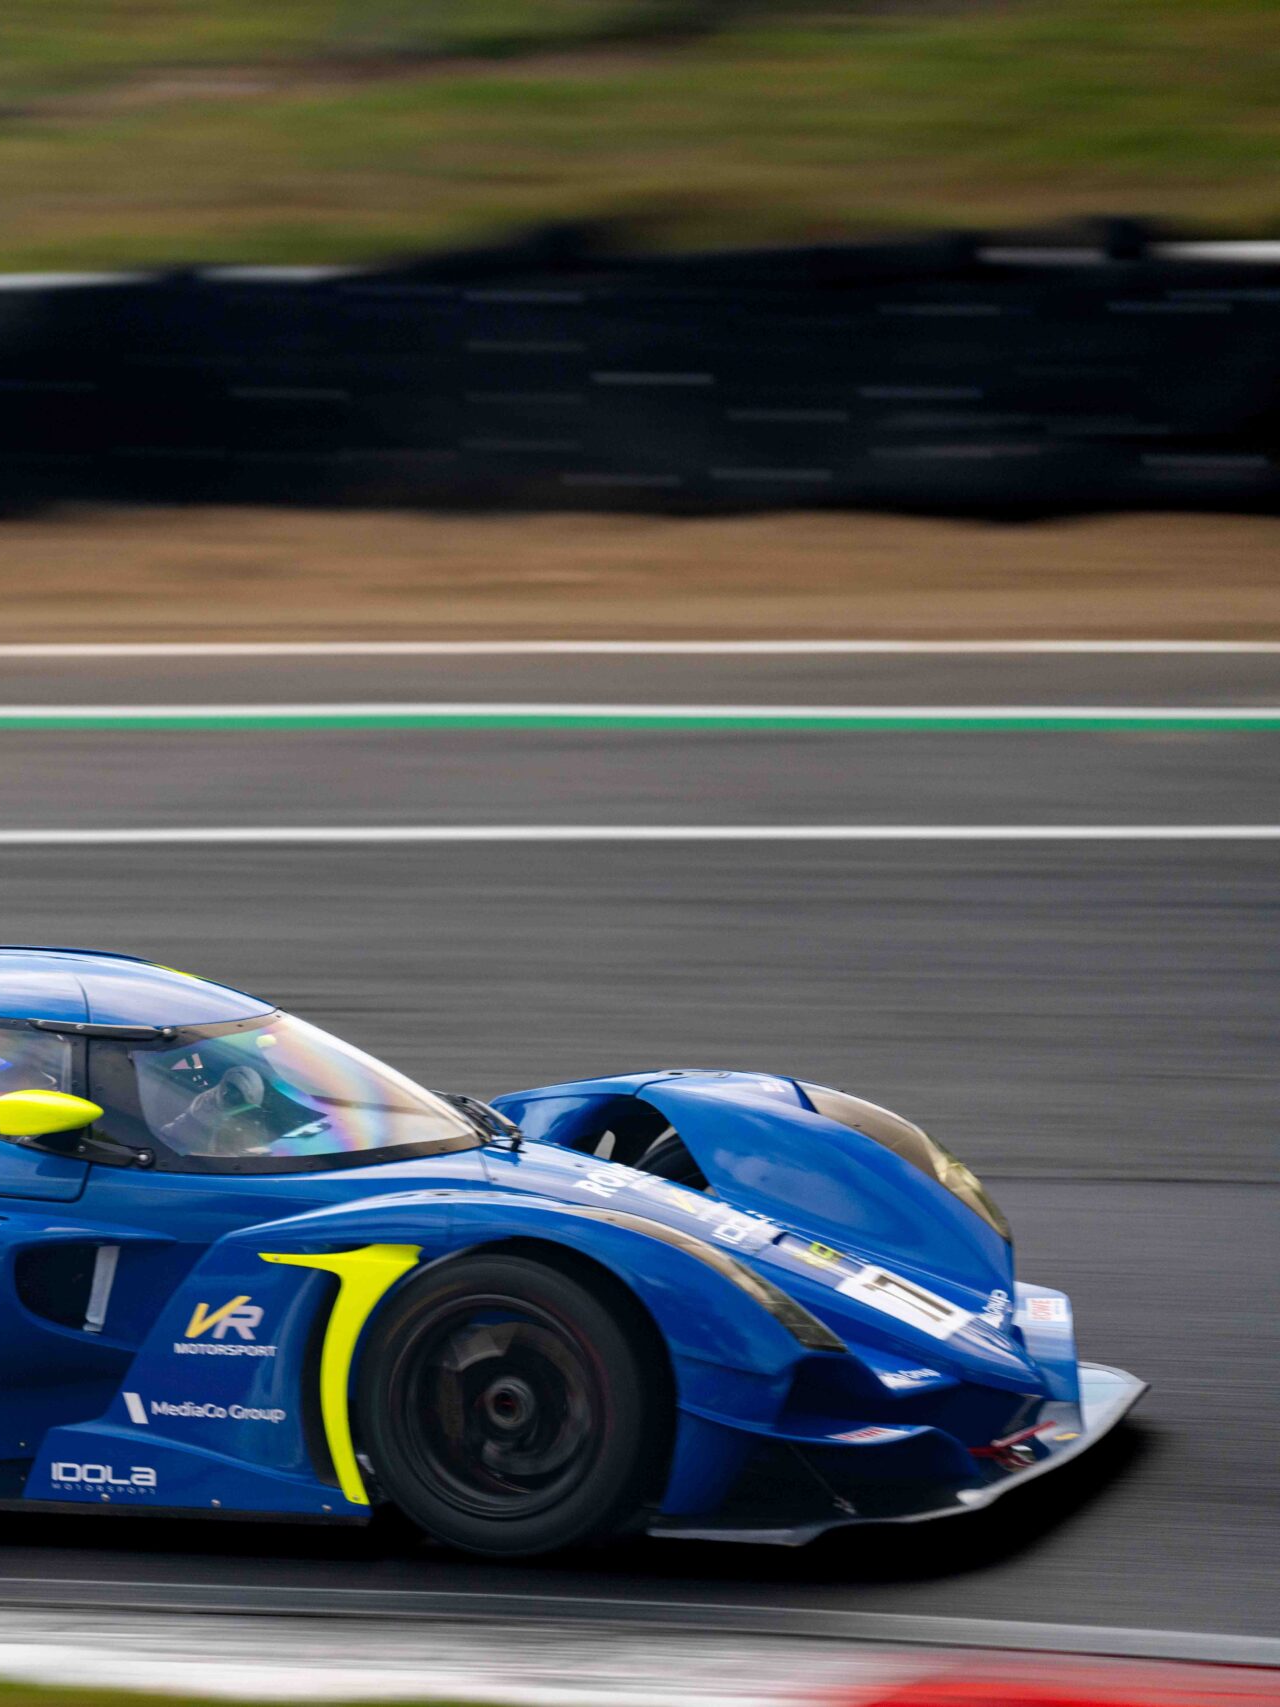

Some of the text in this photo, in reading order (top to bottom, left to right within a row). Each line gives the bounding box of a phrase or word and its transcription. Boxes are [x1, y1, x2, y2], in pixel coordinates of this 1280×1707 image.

[184, 1295, 265, 1340] VR
[173, 1343, 278, 1357] MOTORSPORT
[151, 1400, 287, 1424] MediaCo Group
